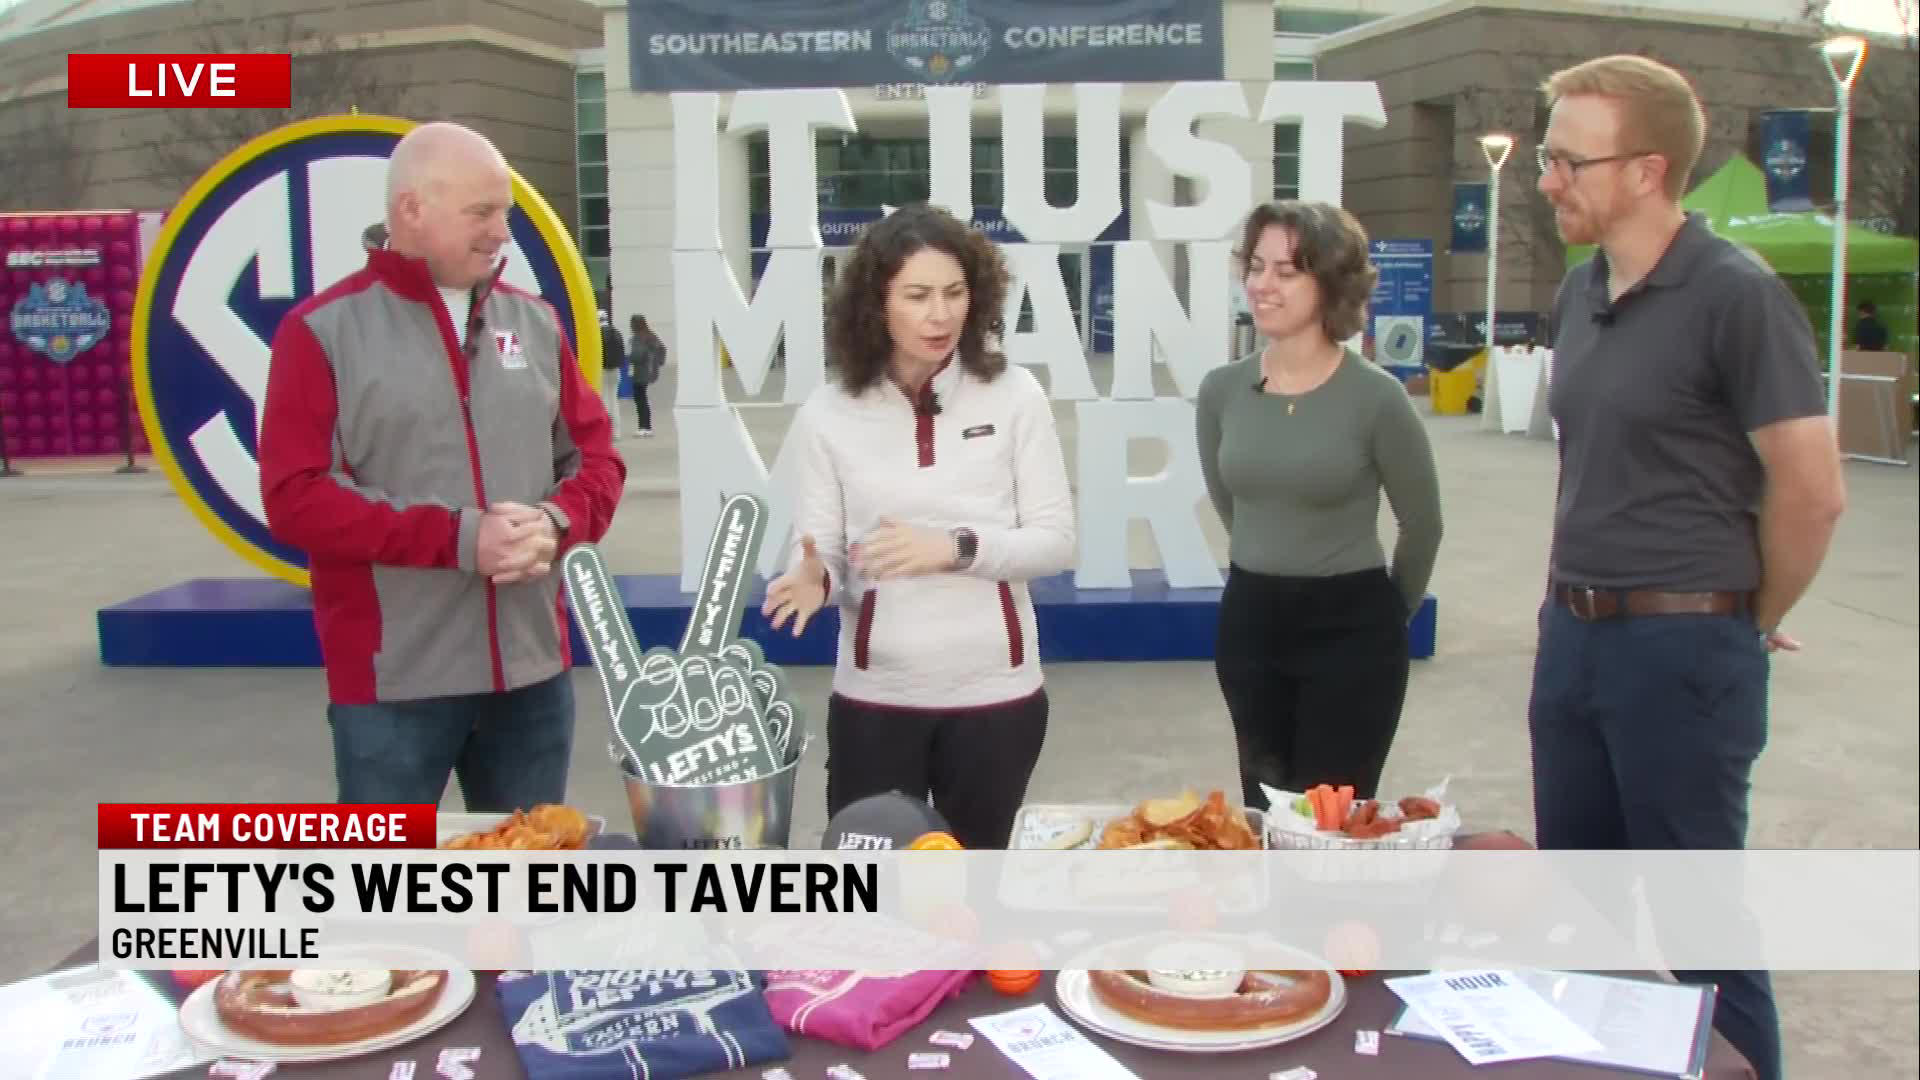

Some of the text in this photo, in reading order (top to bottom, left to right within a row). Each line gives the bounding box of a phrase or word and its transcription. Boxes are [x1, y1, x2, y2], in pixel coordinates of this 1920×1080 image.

[649, 23, 1203, 55] SOUTHEASTERN CONFERENCE
[671, 88, 857, 249] IT
[1444, 972, 1508, 991] HOUR
